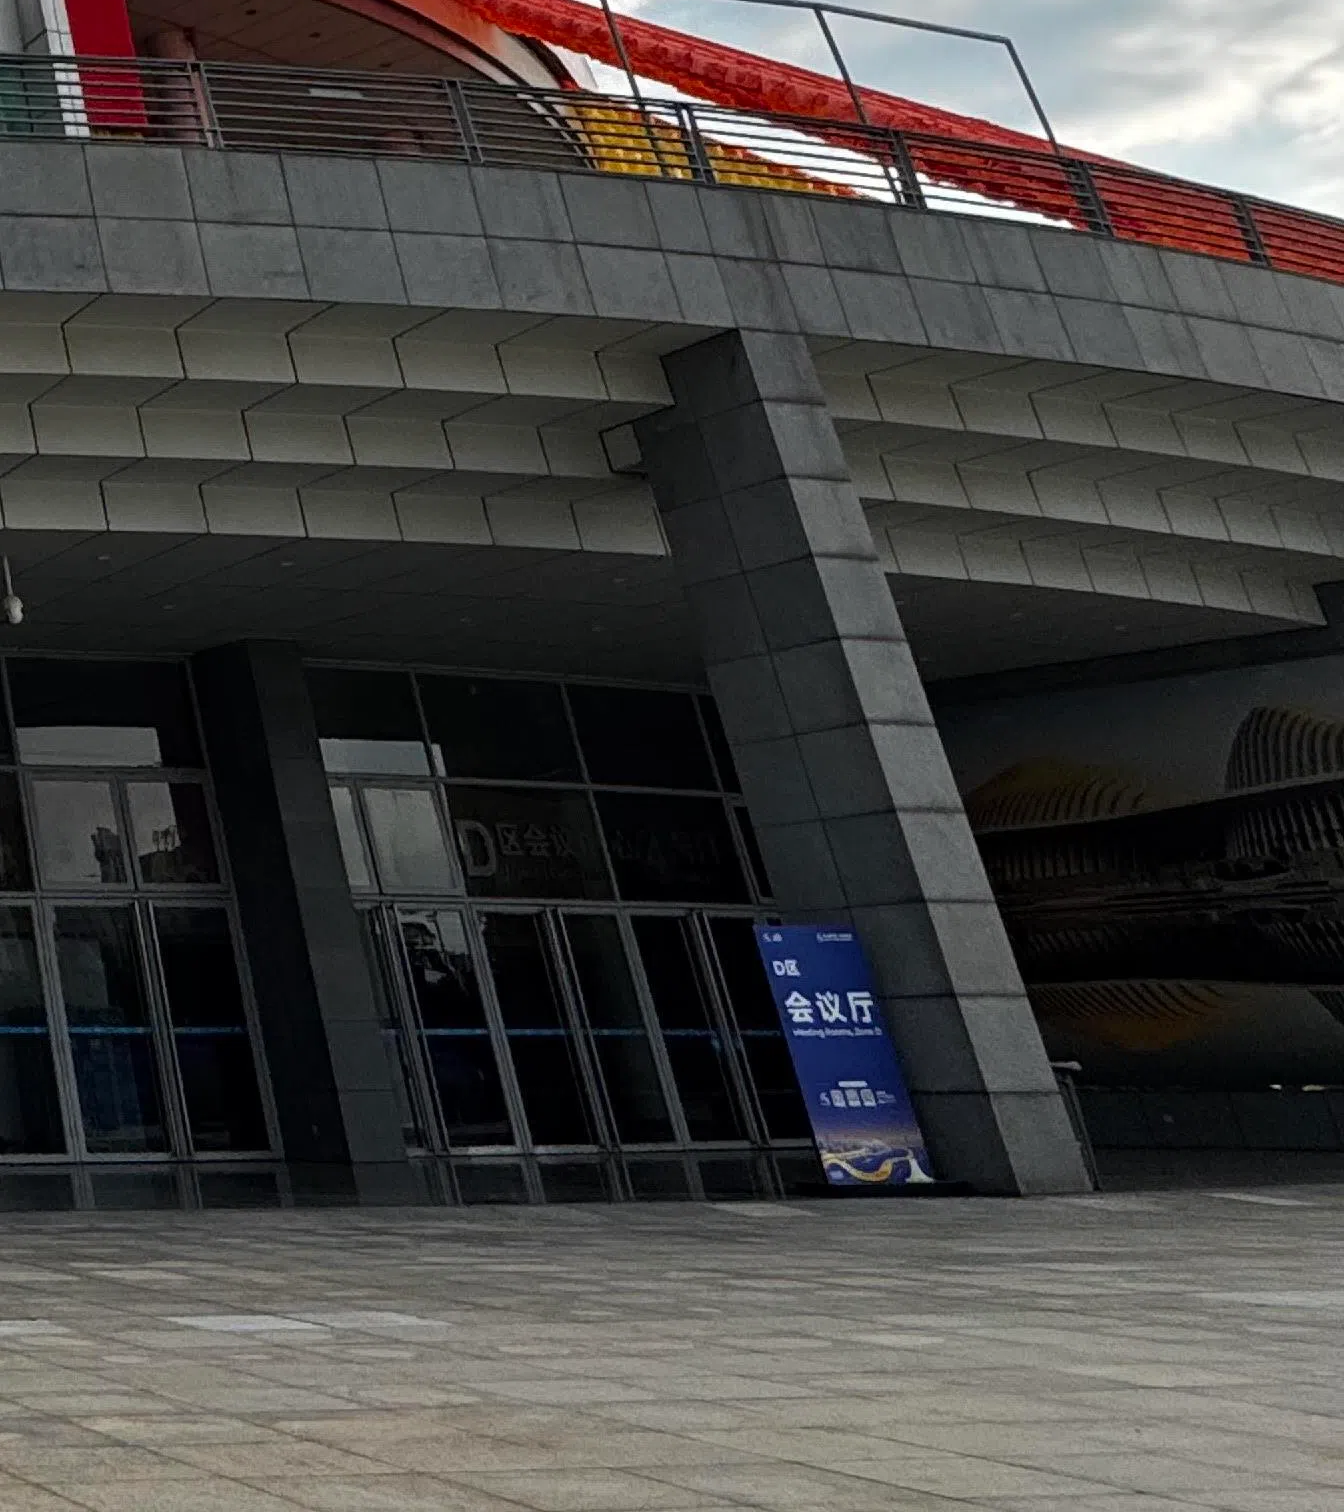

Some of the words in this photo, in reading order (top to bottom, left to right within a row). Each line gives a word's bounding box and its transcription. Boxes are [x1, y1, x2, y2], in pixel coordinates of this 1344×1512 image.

[772, 959, 801, 977] D区
[784, 991, 874, 1023] 会议厅
